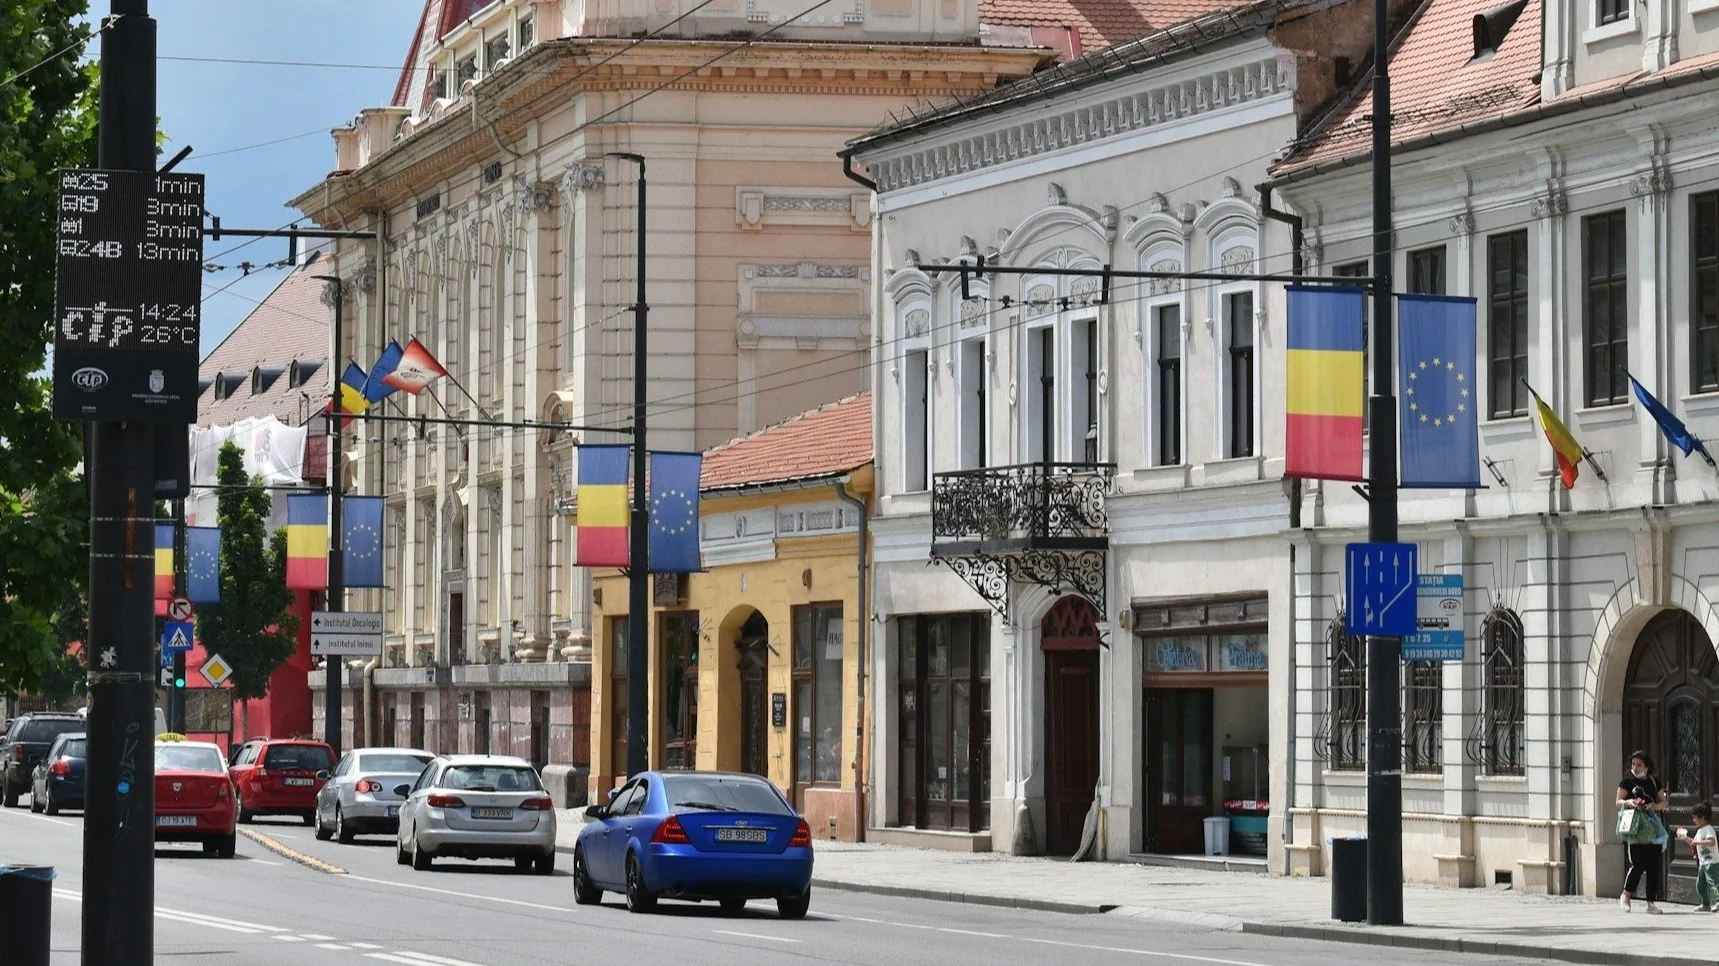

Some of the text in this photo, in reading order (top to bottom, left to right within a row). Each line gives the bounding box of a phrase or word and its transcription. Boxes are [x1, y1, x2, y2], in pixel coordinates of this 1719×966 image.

[79, 173, 201, 194] 25 1min
[80, 195, 200, 216] 19 3min
[147, 220, 199, 239] 3min
[77, 240, 199, 261] 24B 13min
[140, 302, 197, 321] 14:24
[140, 325, 196, 344] 26°C
[324, 617, 380, 630] Institutul Oncologic
[329, 640, 355, 648] Institutul
[719, 830, 732, 839] SB
